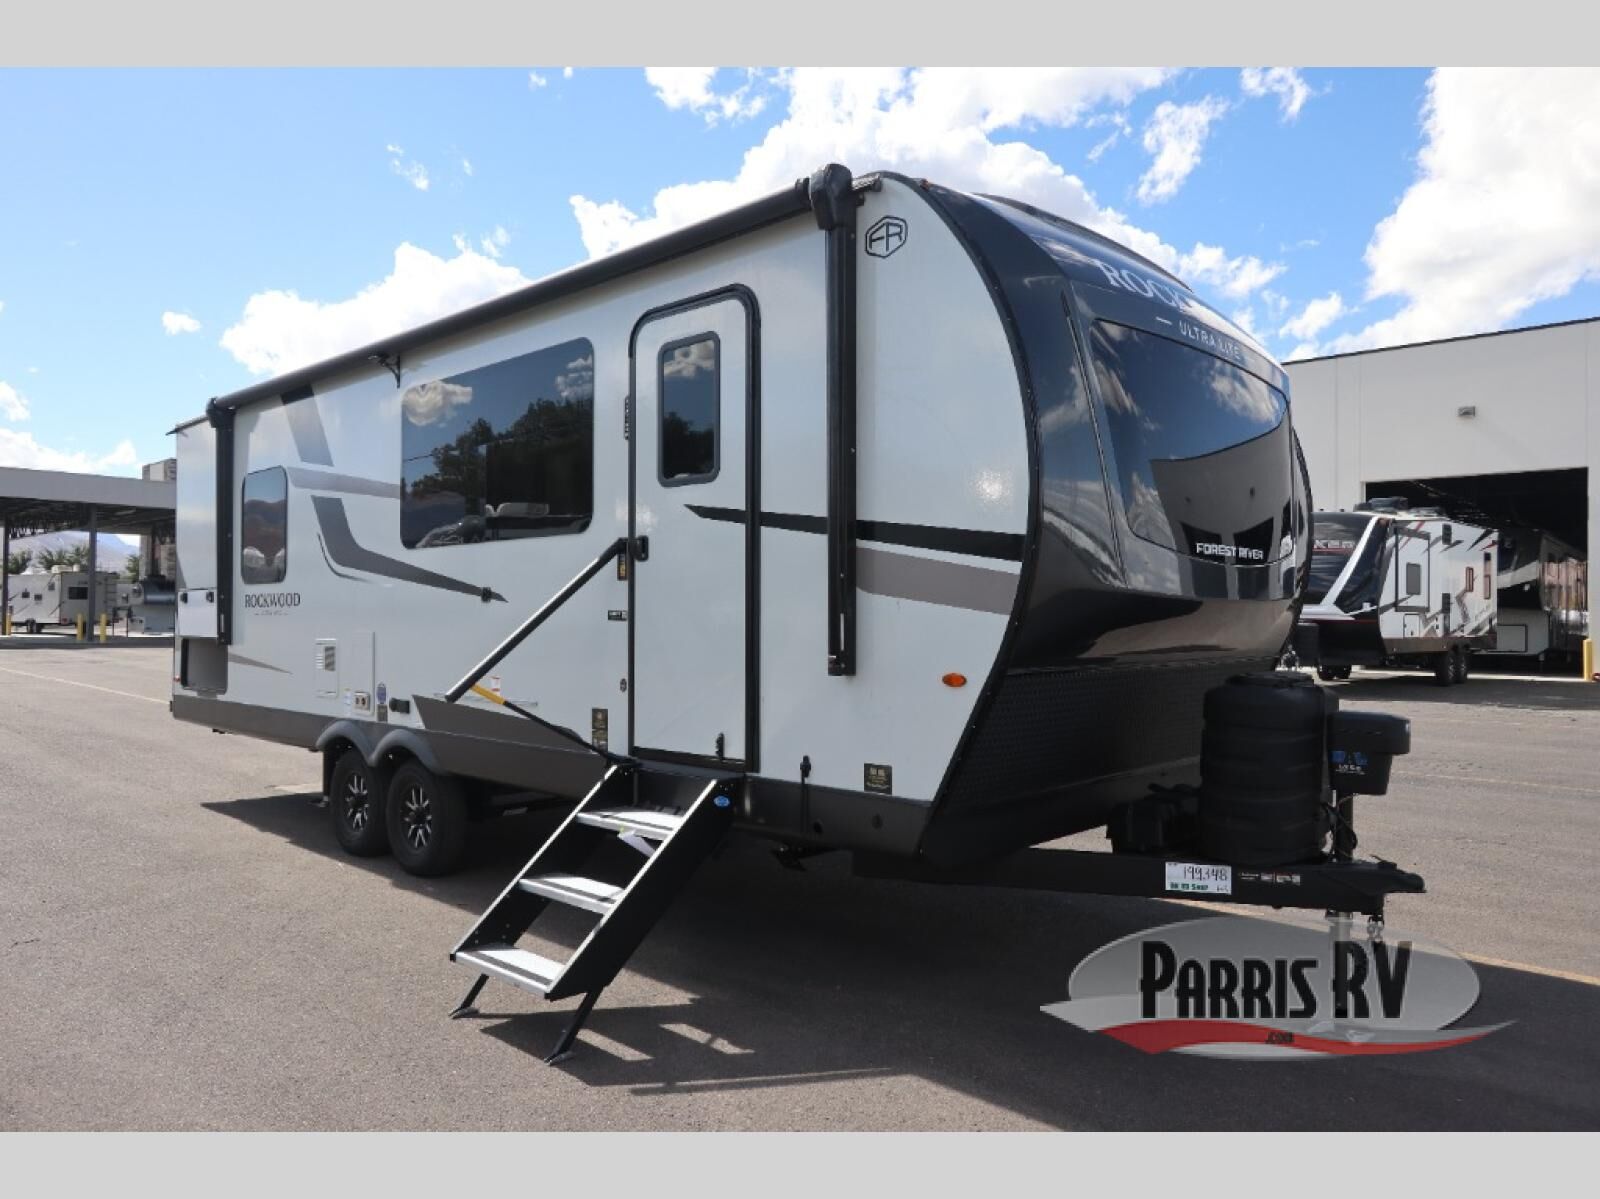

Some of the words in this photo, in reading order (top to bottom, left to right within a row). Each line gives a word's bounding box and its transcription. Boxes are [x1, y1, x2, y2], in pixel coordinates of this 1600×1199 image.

[1179, 319, 1216, 347] ULTRA
[1195, 542, 1237, 558] FOREST
[244, 592, 301, 608] ROCKWOOD
